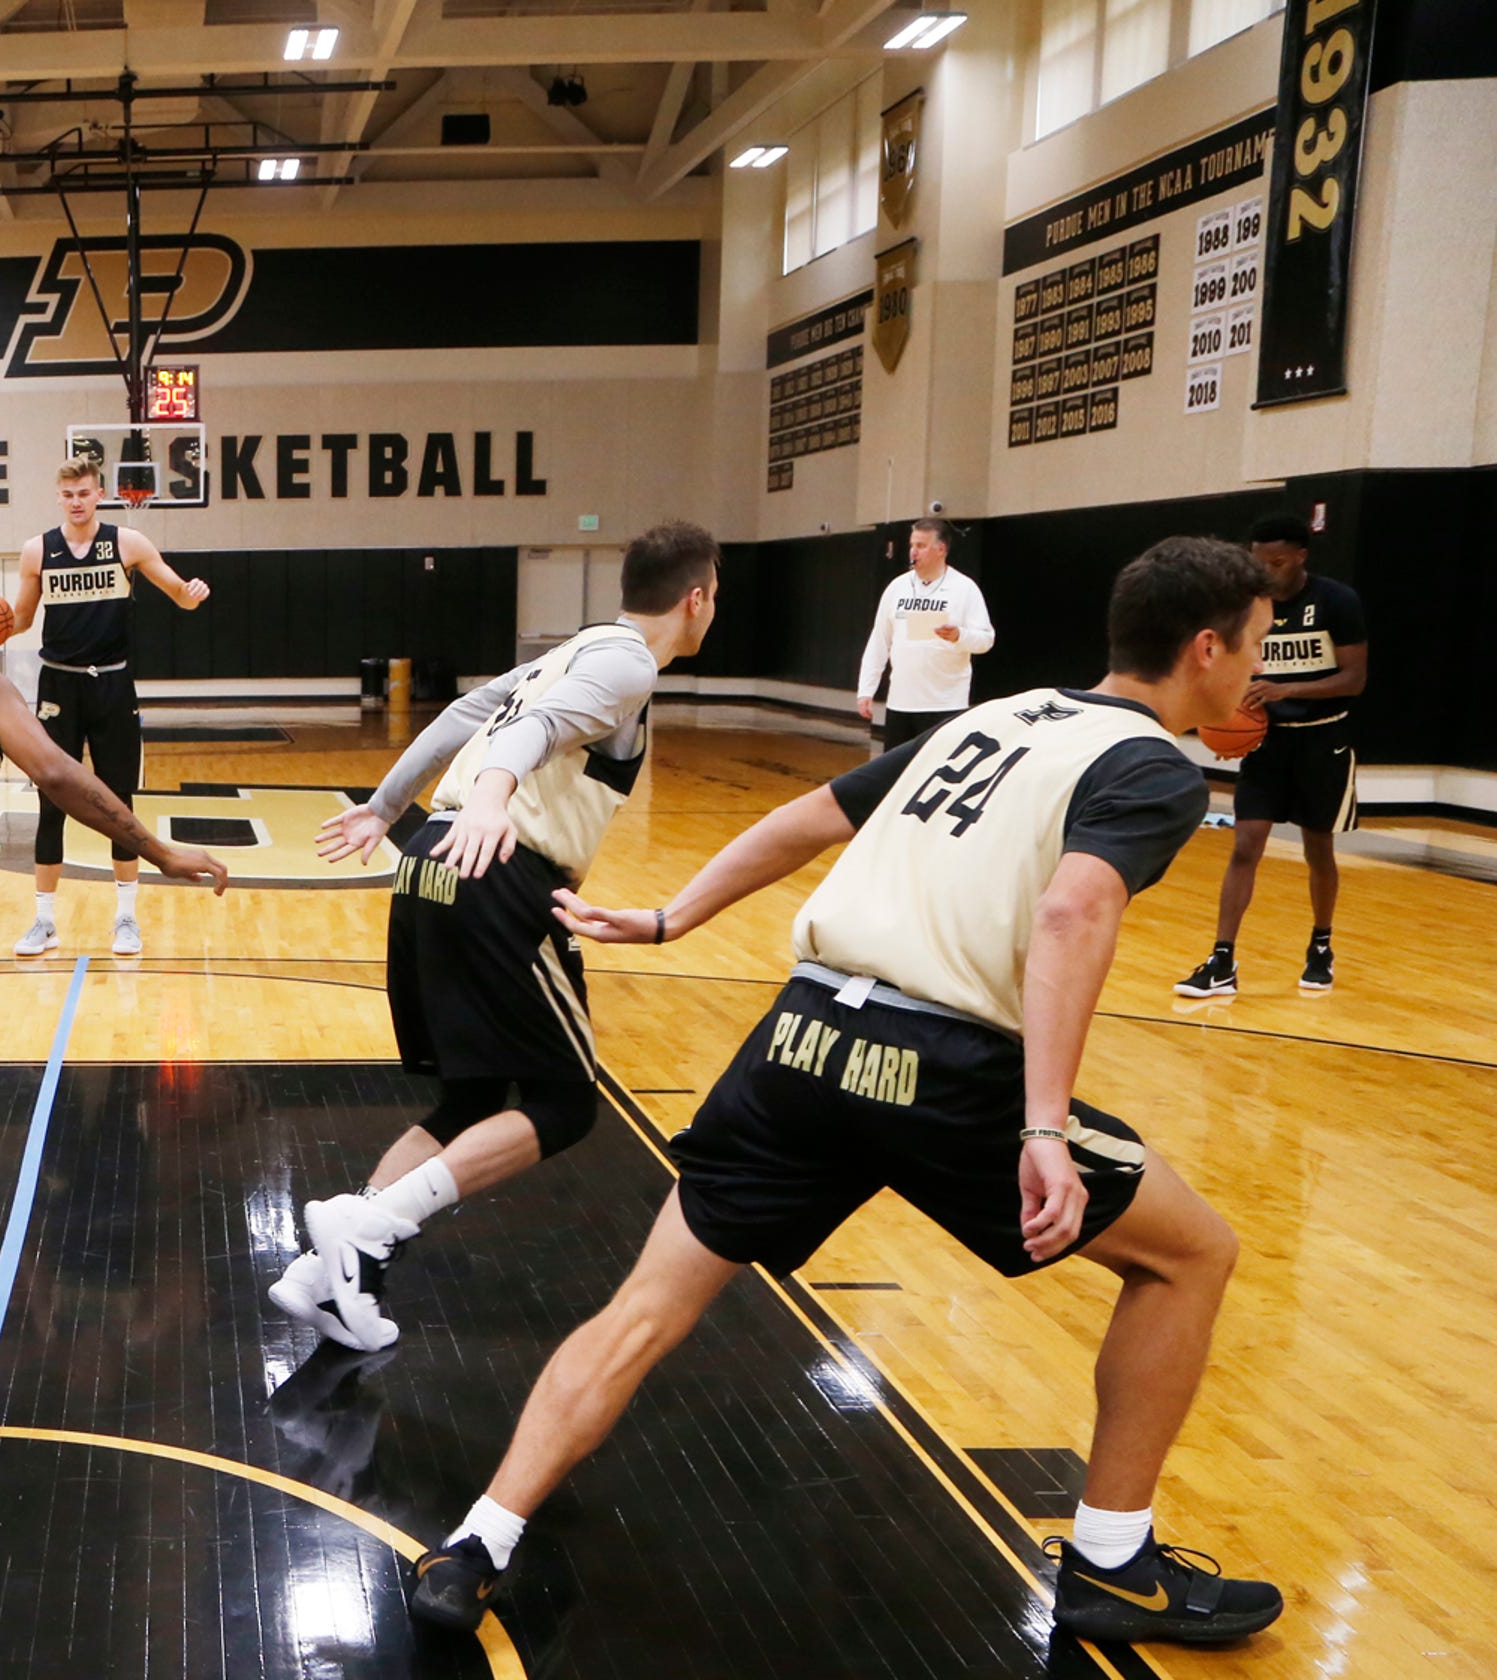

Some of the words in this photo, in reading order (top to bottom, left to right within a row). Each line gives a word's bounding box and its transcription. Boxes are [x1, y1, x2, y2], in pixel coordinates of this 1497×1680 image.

[1088, 198, 1111, 230] MEN
[1115, 191, 1128, 219] IN
[1133, 181, 1153, 212] THE
[1159, 164, 1192, 200] NCAA
[1200, 130, 1275, 185] TOURNAM
[1198, 223, 1229, 256] 1988
[1236, 212, 1261, 244] 199
[1129, 250, 1156, 279] 1986
[1194, 276, 1226, 308] 1999
[1231, 267, 1257, 297] 200
[1191, 328, 1221, 358] 2010
[1229, 320, 1252, 349] 201
[1092, 355, 1119, 382] 2007
[1123, 347, 1151, 374] 2008
[158, 371, 193, 386] 9:14
[155, 387, 187, 415] 25
[1188, 380, 1217, 407] 2018
[95, 541, 114, 560] 32
[49, 570, 115, 593] PURDUE
[896, 598, 949, 612] PURDUE
[1302, 605, 1315, 626] 2
[1261, 638, 1323, 662] URDUE
[901, 731, 1032, 838] 24
[767, 1011, 842, 1077] PLAY
[840, 1038, 919, 1106] HARD
